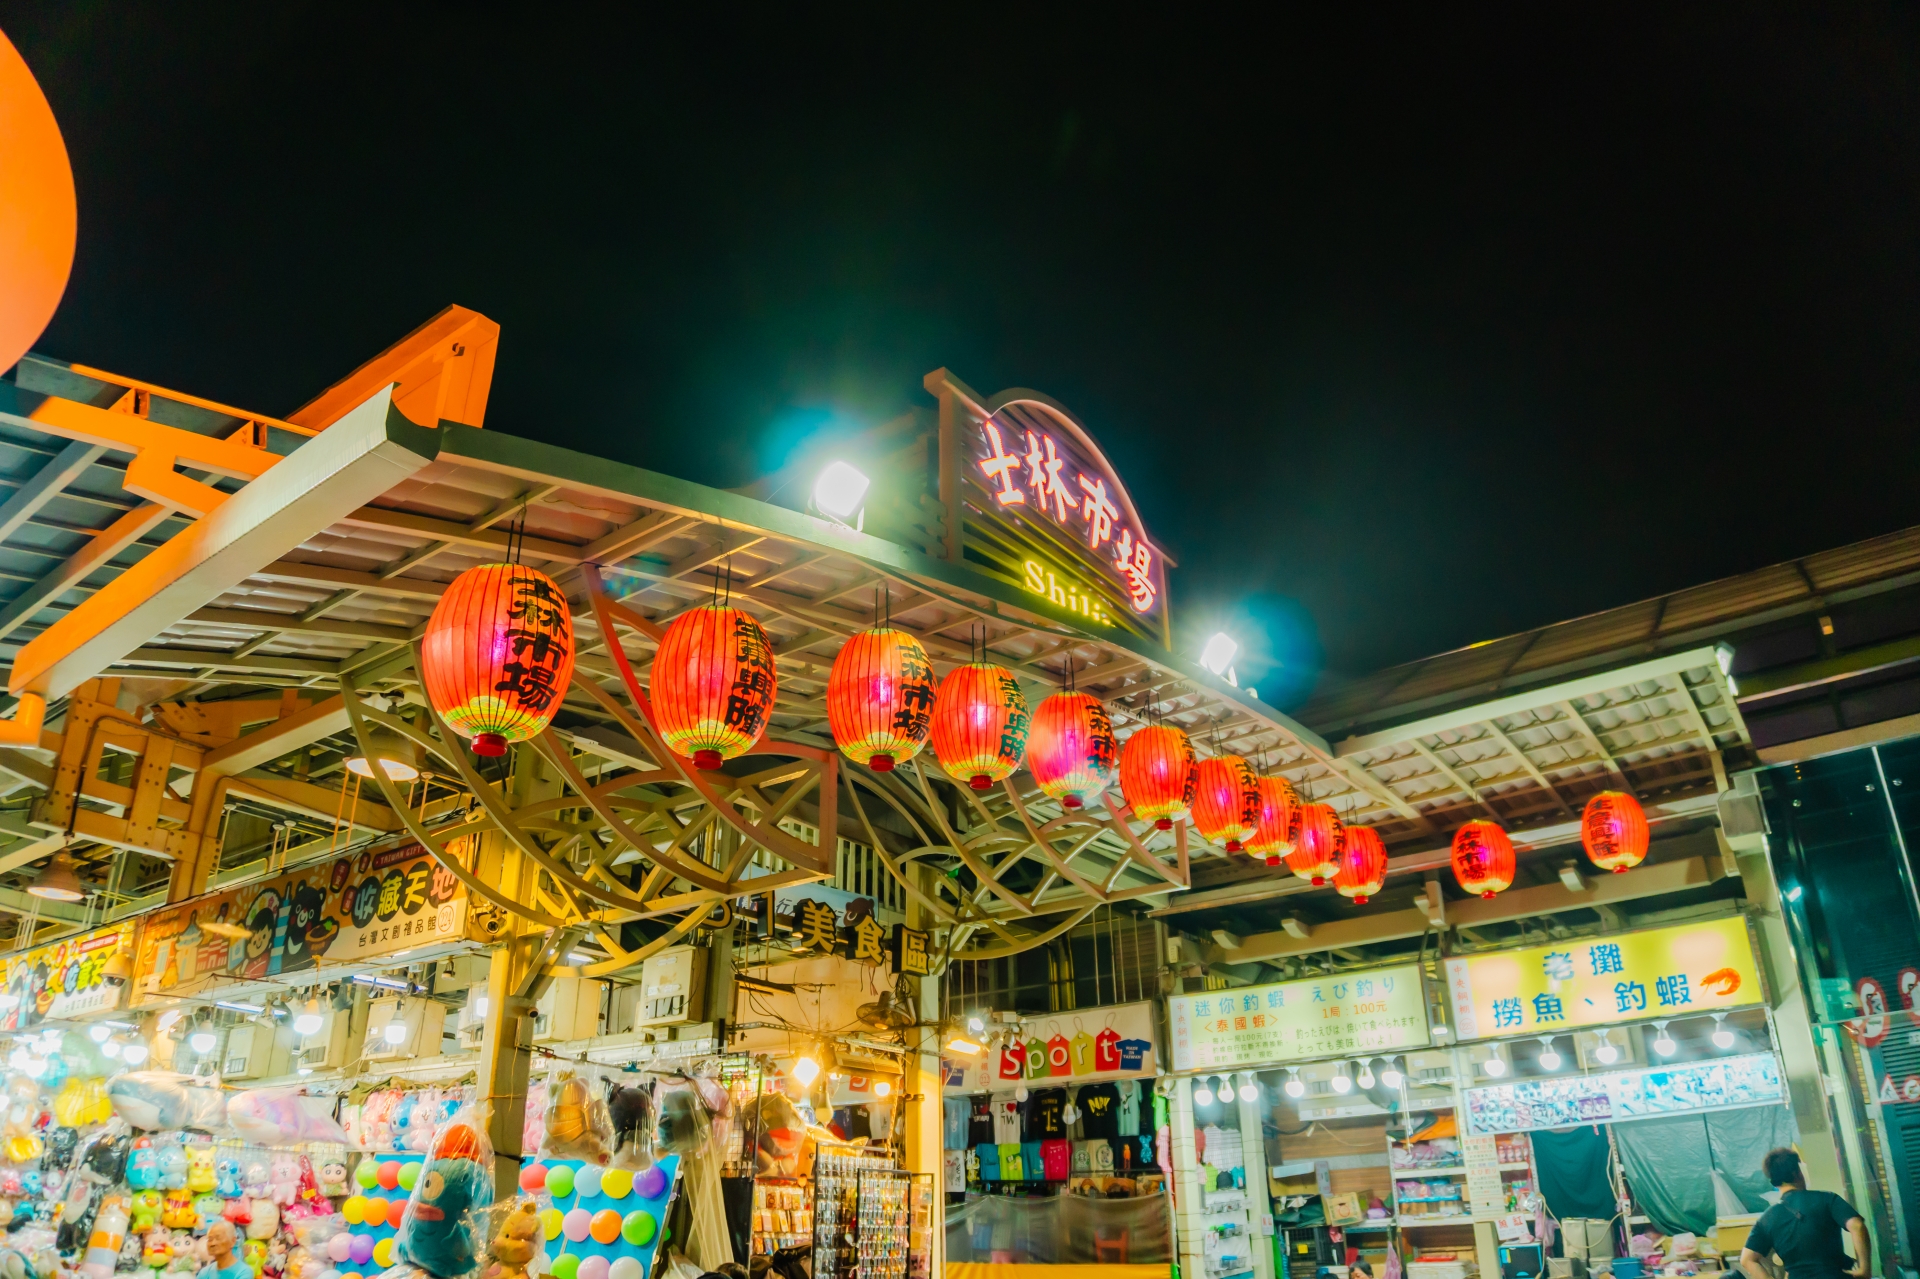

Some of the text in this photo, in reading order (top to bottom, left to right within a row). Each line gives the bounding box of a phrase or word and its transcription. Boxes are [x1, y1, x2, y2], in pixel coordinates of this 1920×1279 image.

[979, 421, 1157, 612] 士林市場
[495, 576, 569, 711] 士林市場
[893, 644, 937, 741] 士林市場
[380, 850, 404, 864] TAIWAN
[405, 845, 421, 857] GIFT
[354, 867, 456, 920] 收藏天地
[359, 915, 437, 948] 台灣文創禮品館
[1543, 943, 1624, 981] 老攤
[1195, 976, 1396, 1018] 迷你釣蝦 えび釣り
[1003, 1039, 1114, 1077] Sport
